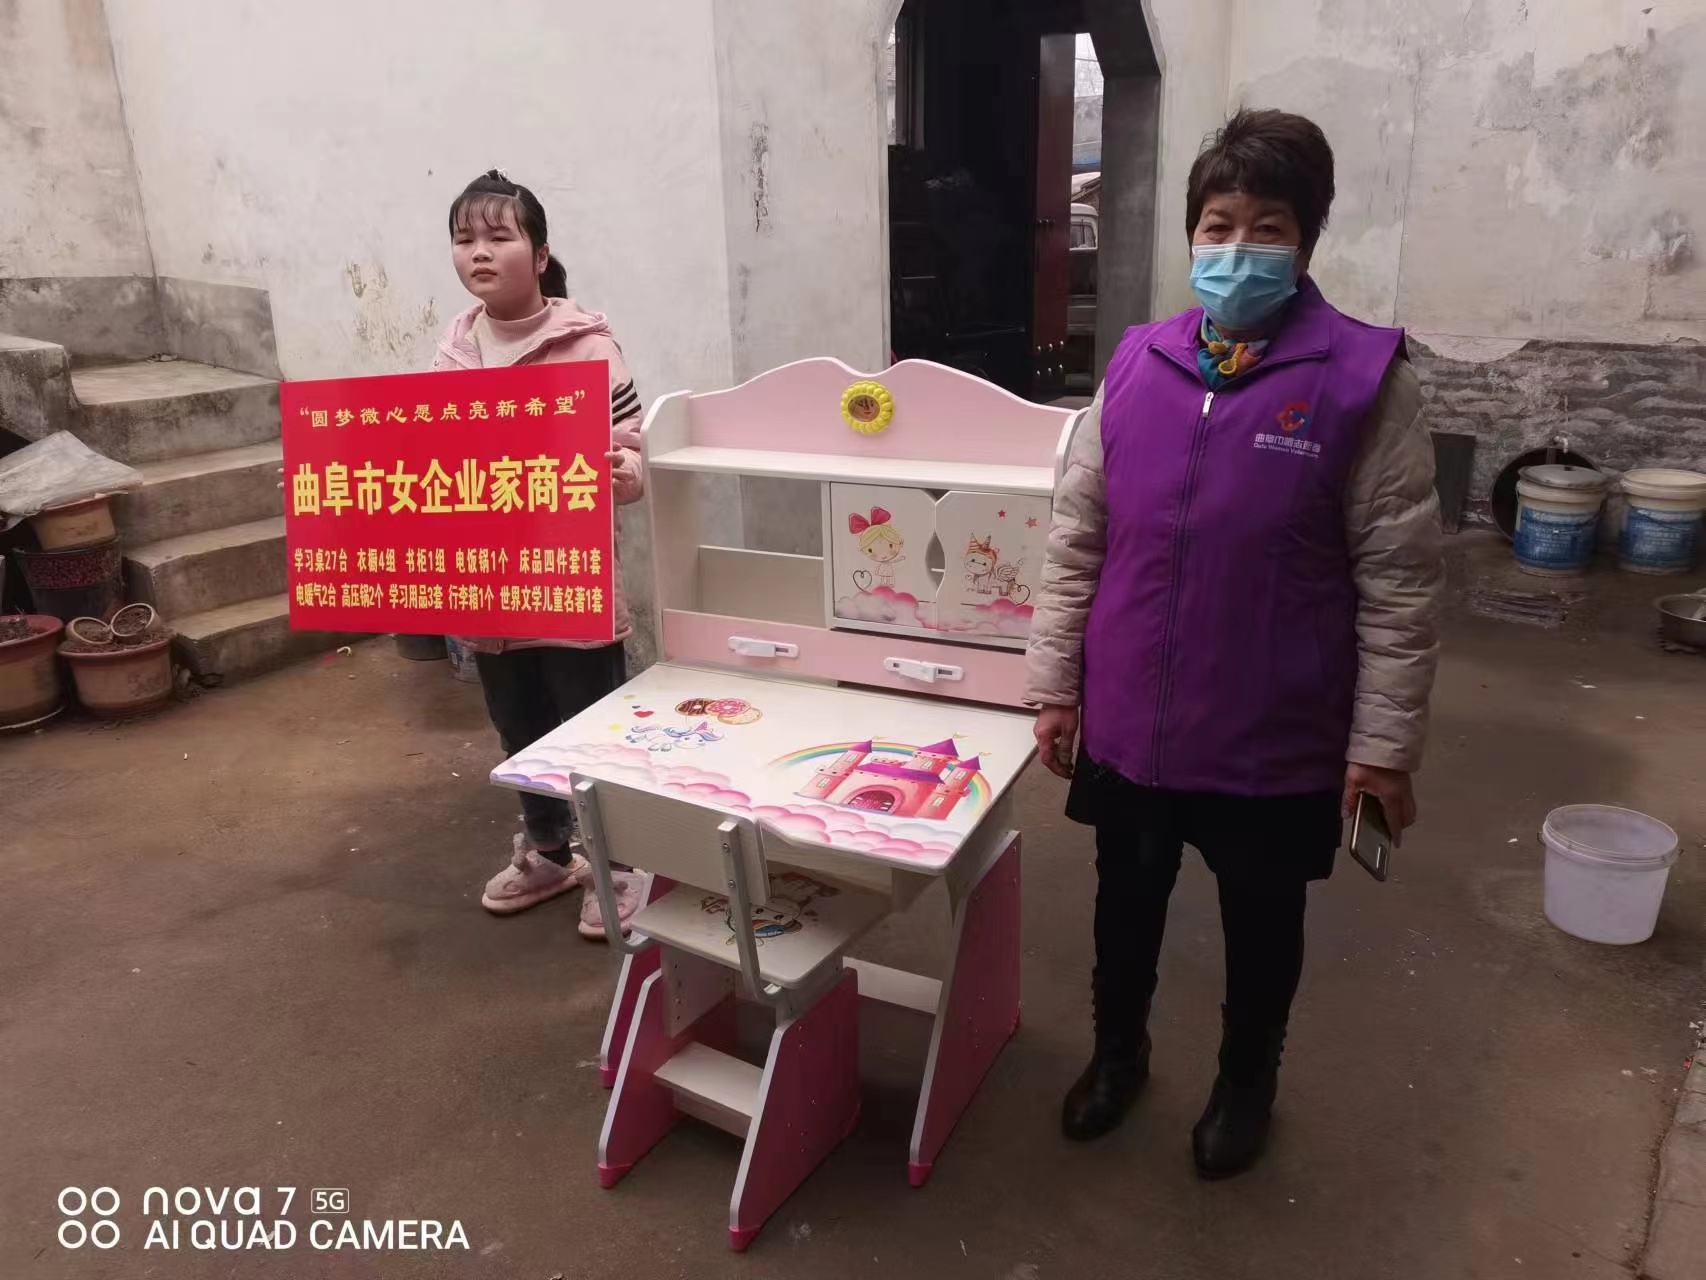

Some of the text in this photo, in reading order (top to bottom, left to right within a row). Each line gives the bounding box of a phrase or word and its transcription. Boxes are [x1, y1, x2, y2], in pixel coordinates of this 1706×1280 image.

[299, 389, 586, 428] “圆梦微心愿点亮新希望”
[292, 452, 599, 517] 曲阜市女企业家商会
[294, 547, 602, 575] 学习桌27台 衣橱4组 书柜1组 电饭锅1个 床品四件套1套
[295, 582, 603, 614] 电暖气2台 高压锅2个 学习用品3套 行李箱1个 世界文学儿童名著1套
